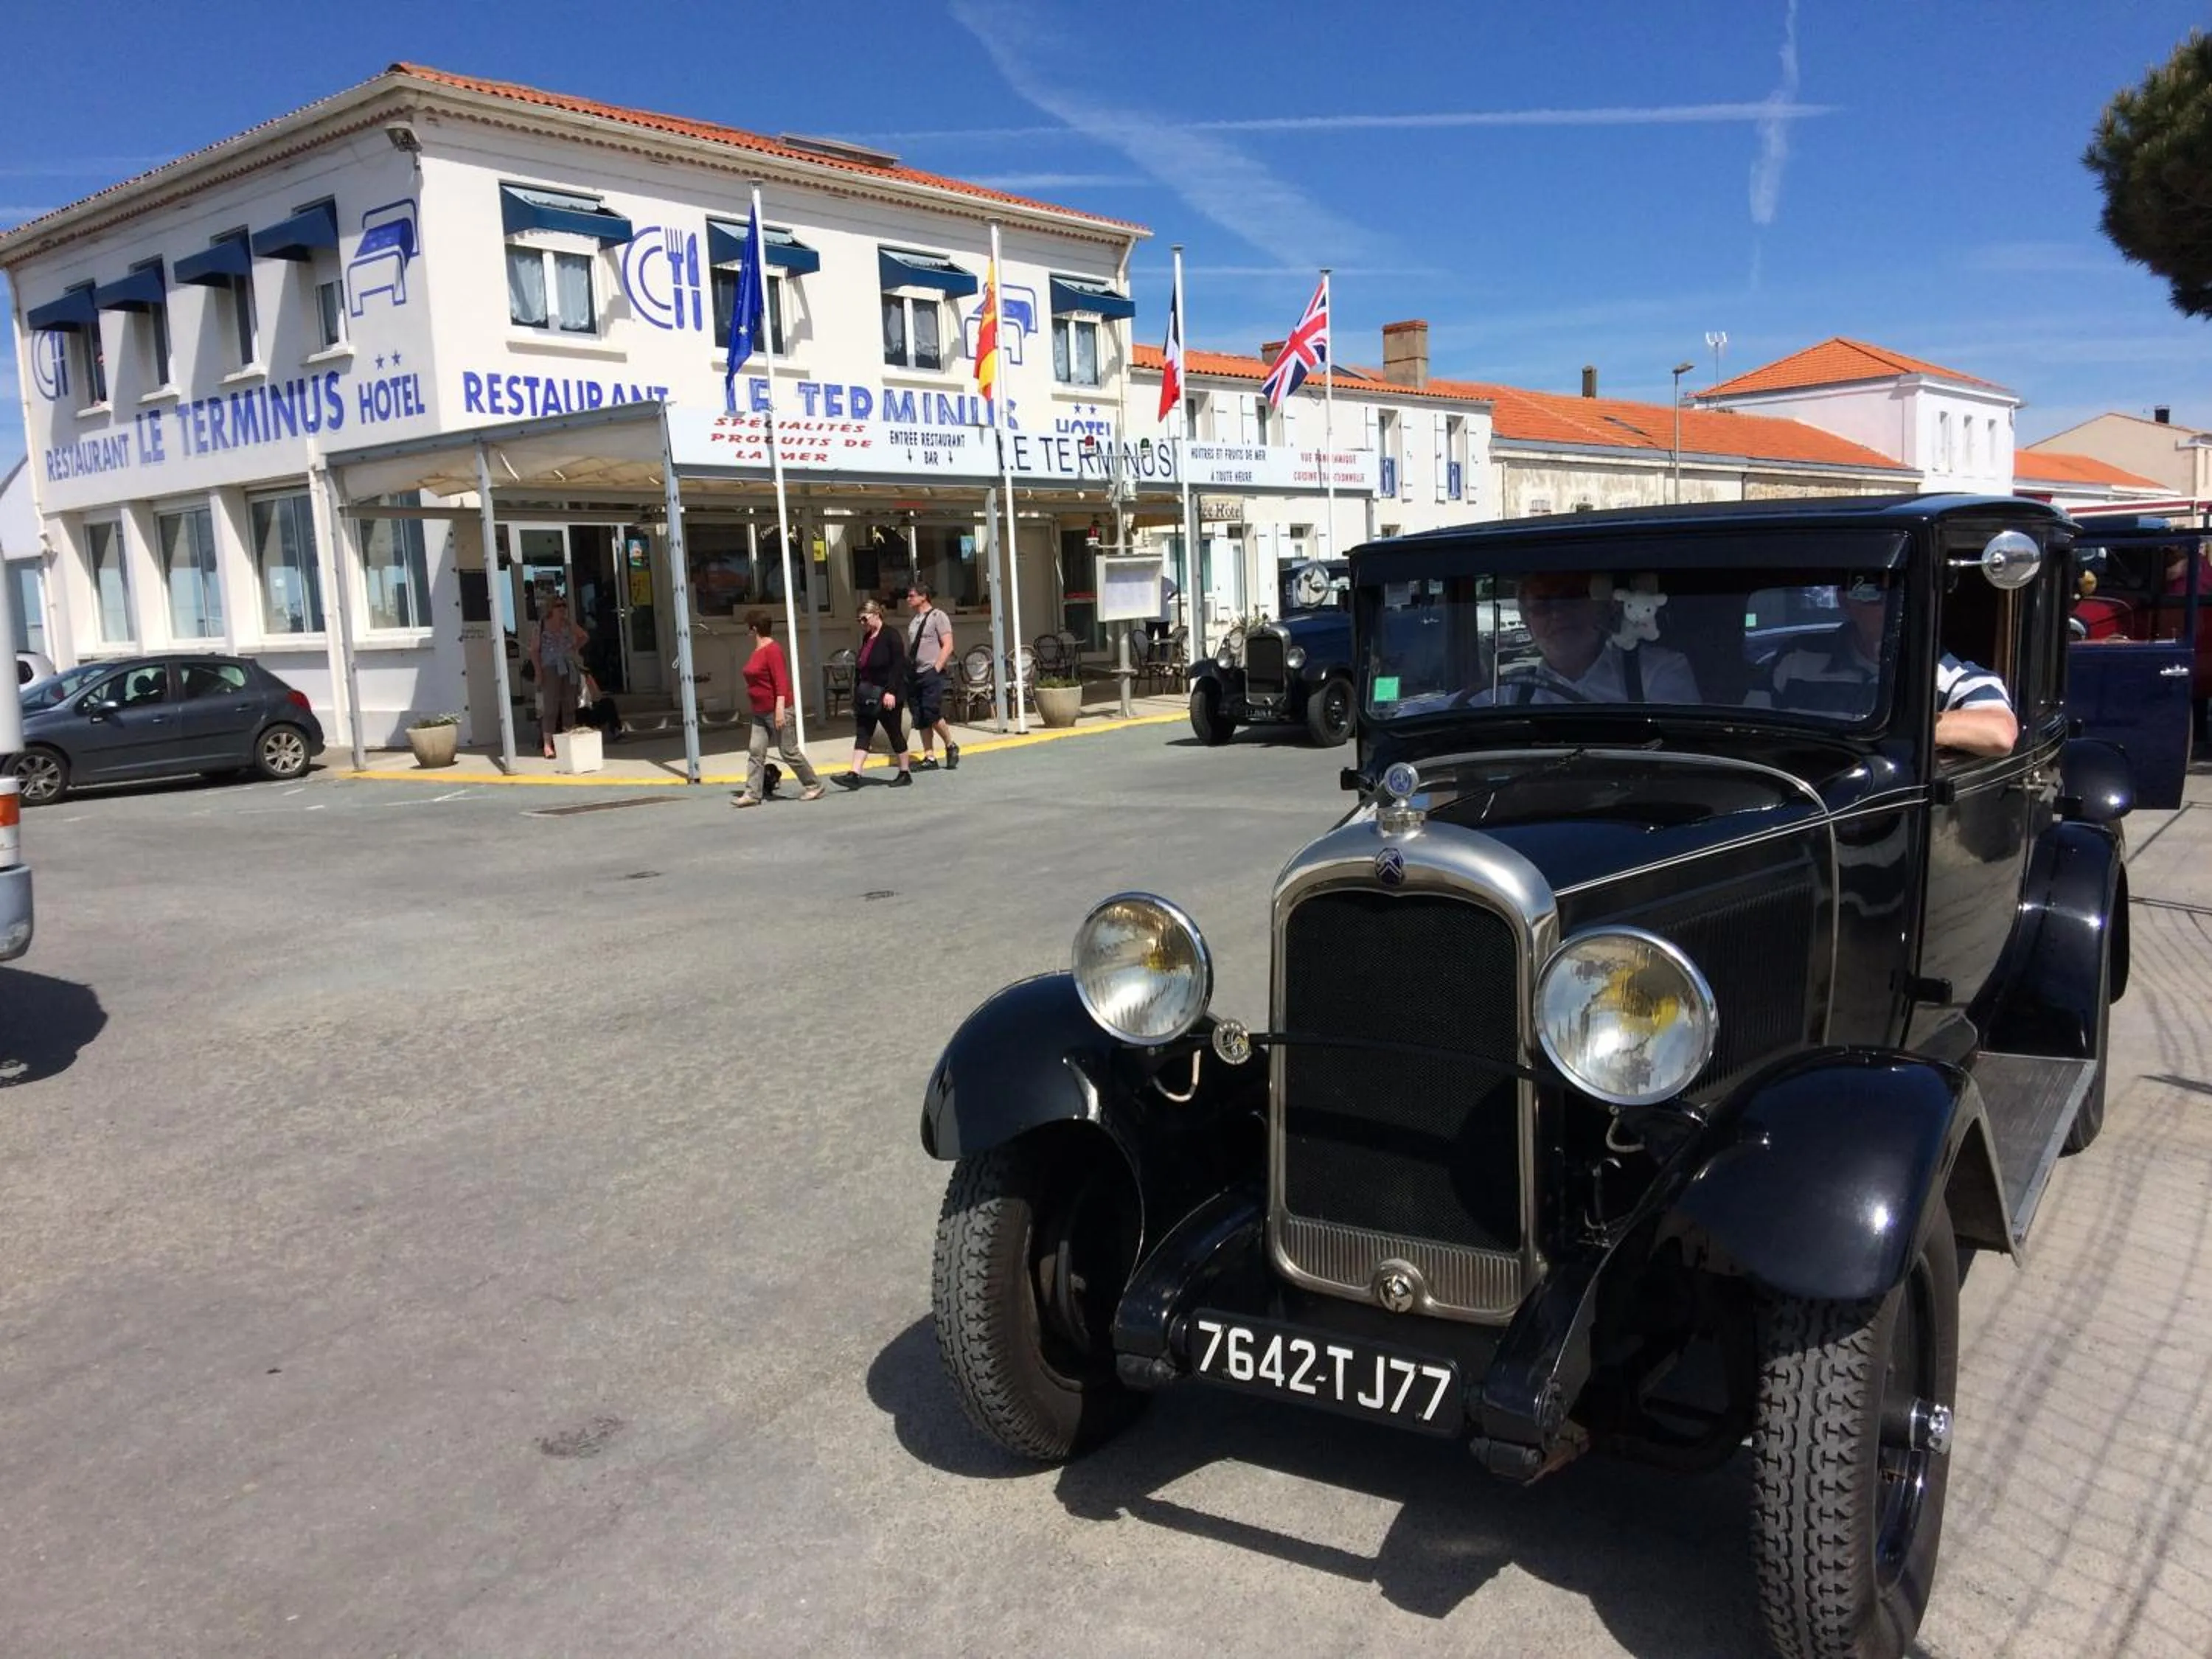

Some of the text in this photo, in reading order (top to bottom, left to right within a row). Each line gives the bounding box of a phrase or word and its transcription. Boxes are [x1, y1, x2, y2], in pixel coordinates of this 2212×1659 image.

[358, 373, 425, 425] HOTEL
[46, 370, 344, 481] RESTAURANT LE TERMINUS
[844, 439, 873, 448] DE
[889, 428, 965, 448] ENTRÉE RESTAURANT
[736, 451, 762, 460] LA
[924, 451, 939, 465] BAR
[996, 434, 1172, 478] LE TERMNUS
